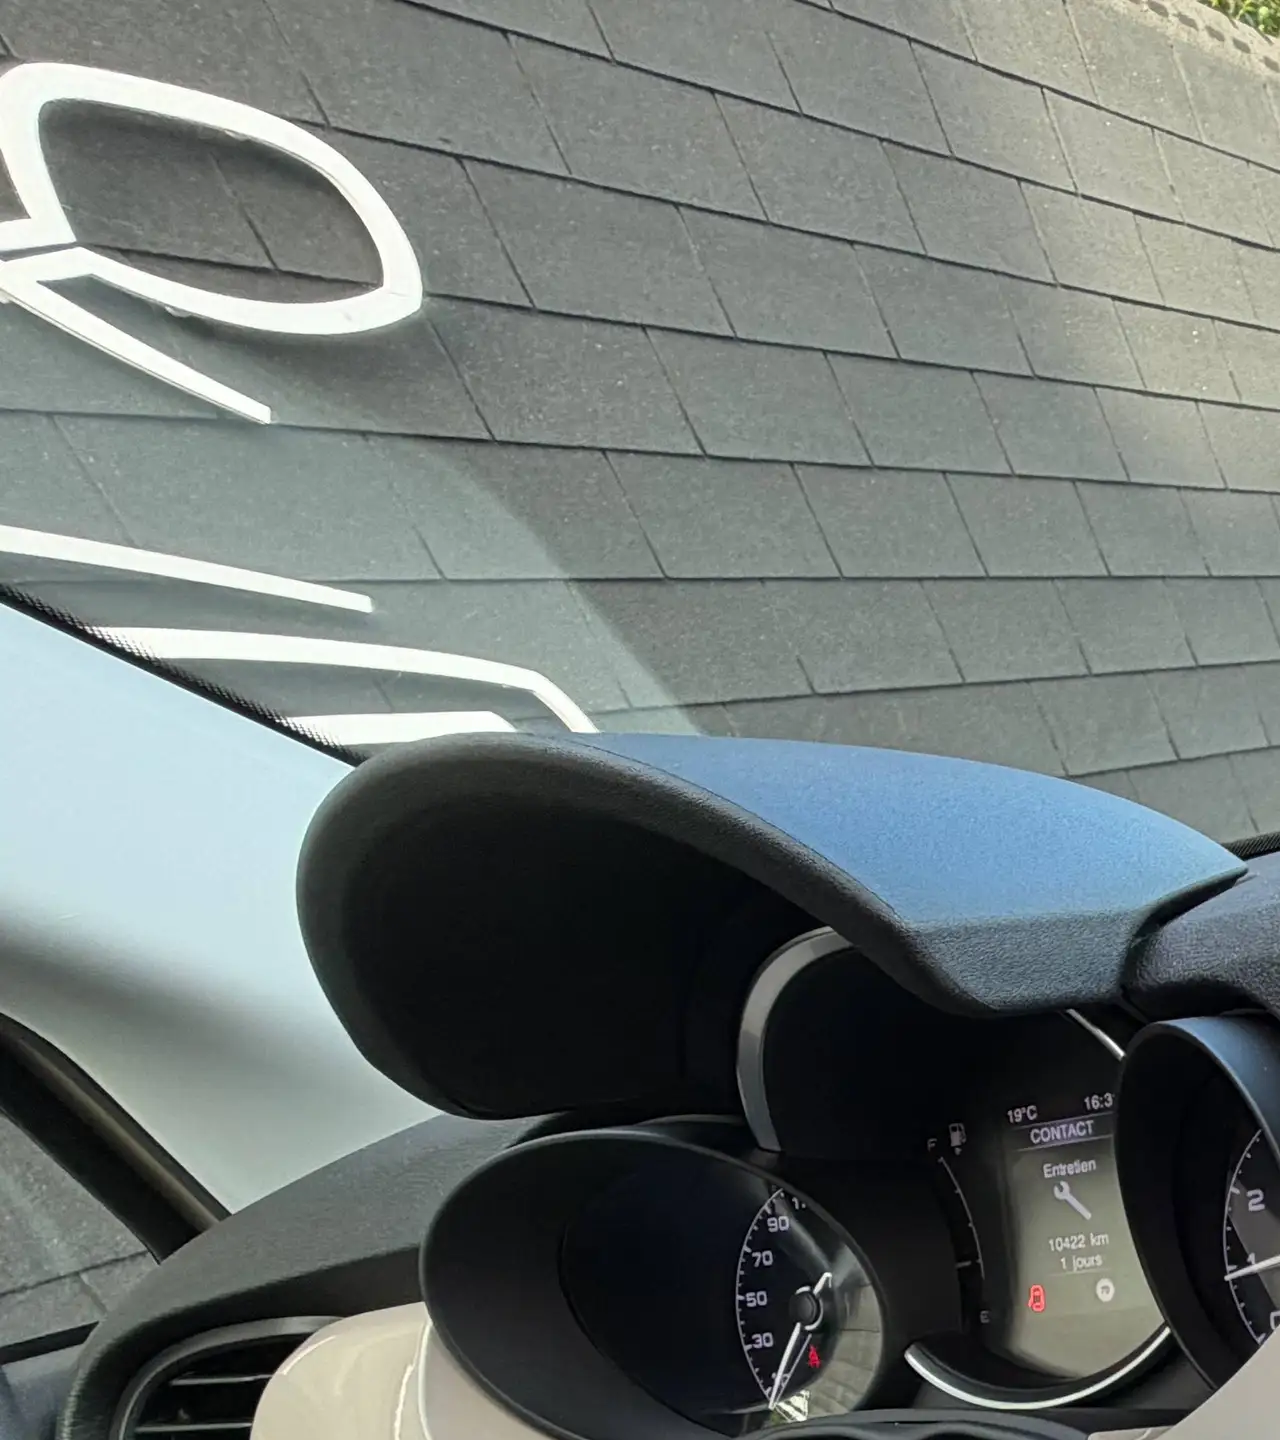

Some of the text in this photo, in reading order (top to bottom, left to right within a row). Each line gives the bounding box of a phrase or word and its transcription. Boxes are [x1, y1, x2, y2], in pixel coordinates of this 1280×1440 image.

[1084, 1092, 1115, 1111] 16:3
[1007, 1105, 1037, 1123] 19°C
[1030, 1120, 1094, 1144] CONTACT
[1043, 1159, 1096, 1179] Entretien
[1247, 1189, 1265, 1211] 2
[767, 1216, 789, 1232] 90
[1090, 1231, 1109, 1246] km
[752, 1250, 773, 1266] 70
[1072, 1254, 1102, 1273] jours
[746, 1291, 767, 1307] 50
[751, 1333, 773, 1349] 30
